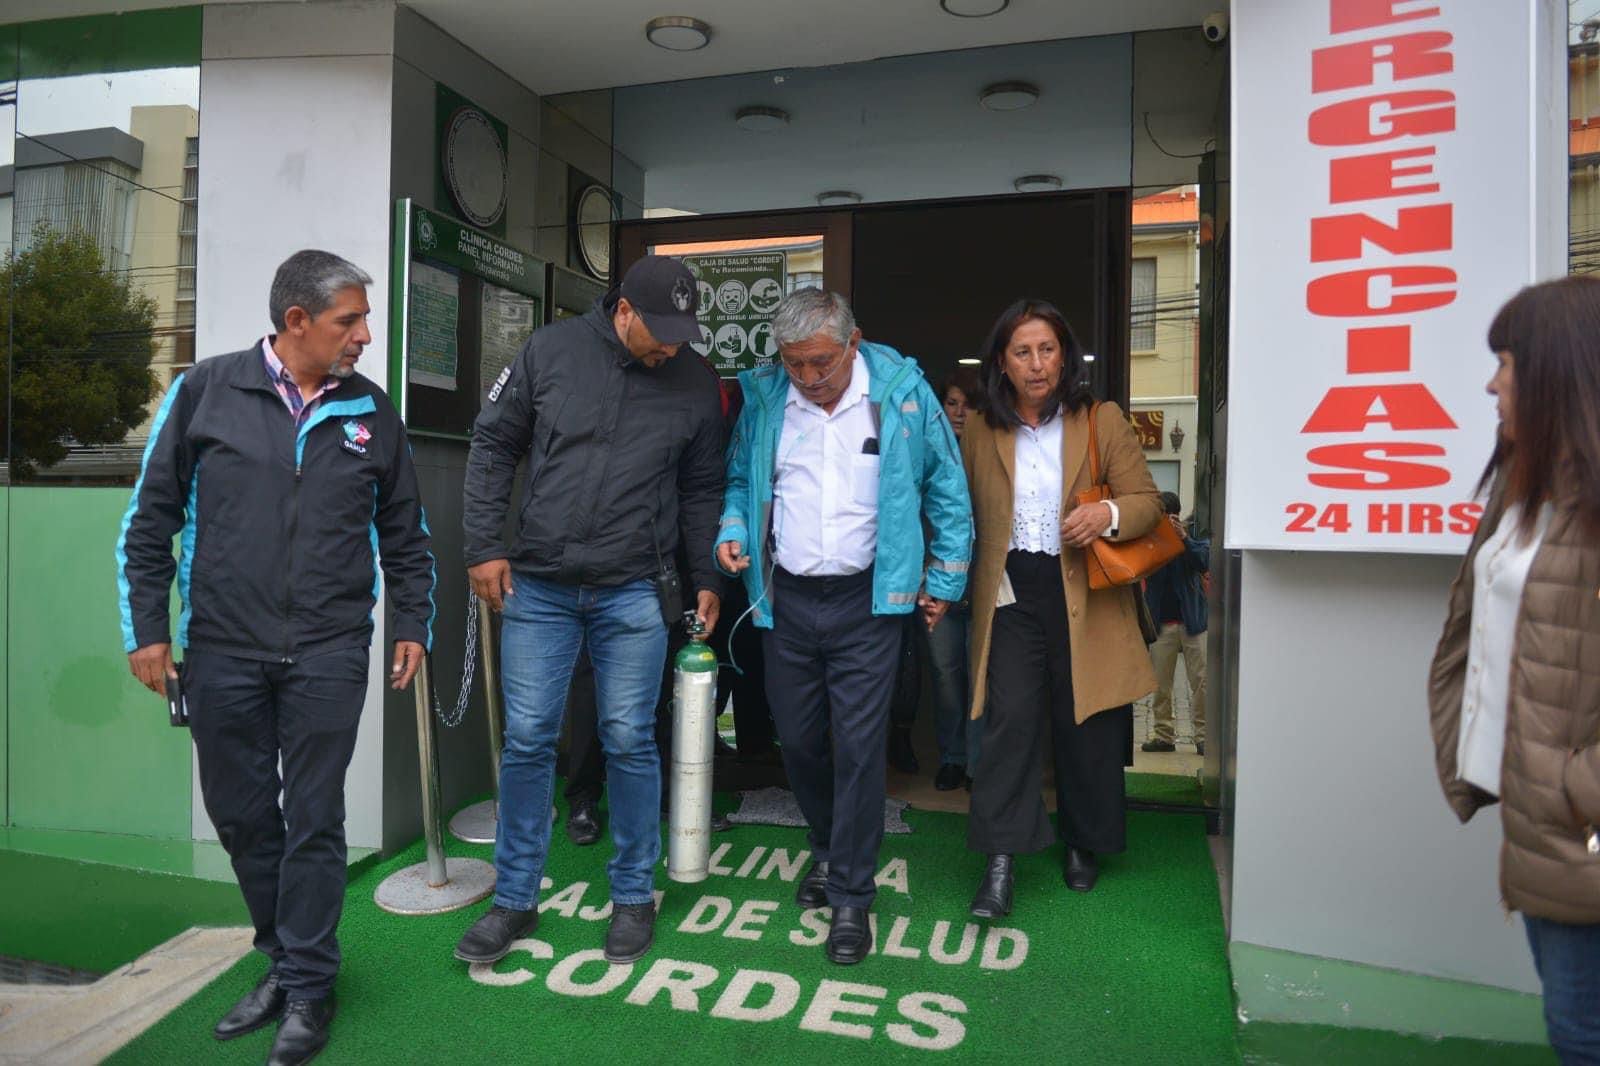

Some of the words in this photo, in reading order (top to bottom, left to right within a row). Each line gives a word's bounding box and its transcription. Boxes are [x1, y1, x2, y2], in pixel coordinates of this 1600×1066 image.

[458, 241, 481, 259] PANEL
[482, 250, 525, 276] INFORMATIVO
[493, 243, 524, 265] CORDES
[699, 258, 718, 266] CAJA
[718, 258, 727, 266] DE
[727, 257, 749, 265] SALUD
[1285, 502, 1351, 534] 24
[1367, 502, 1484, 535] HRS
[676, 895, 780, 941] DE
[467, 938, 968, 1051] CORDES
